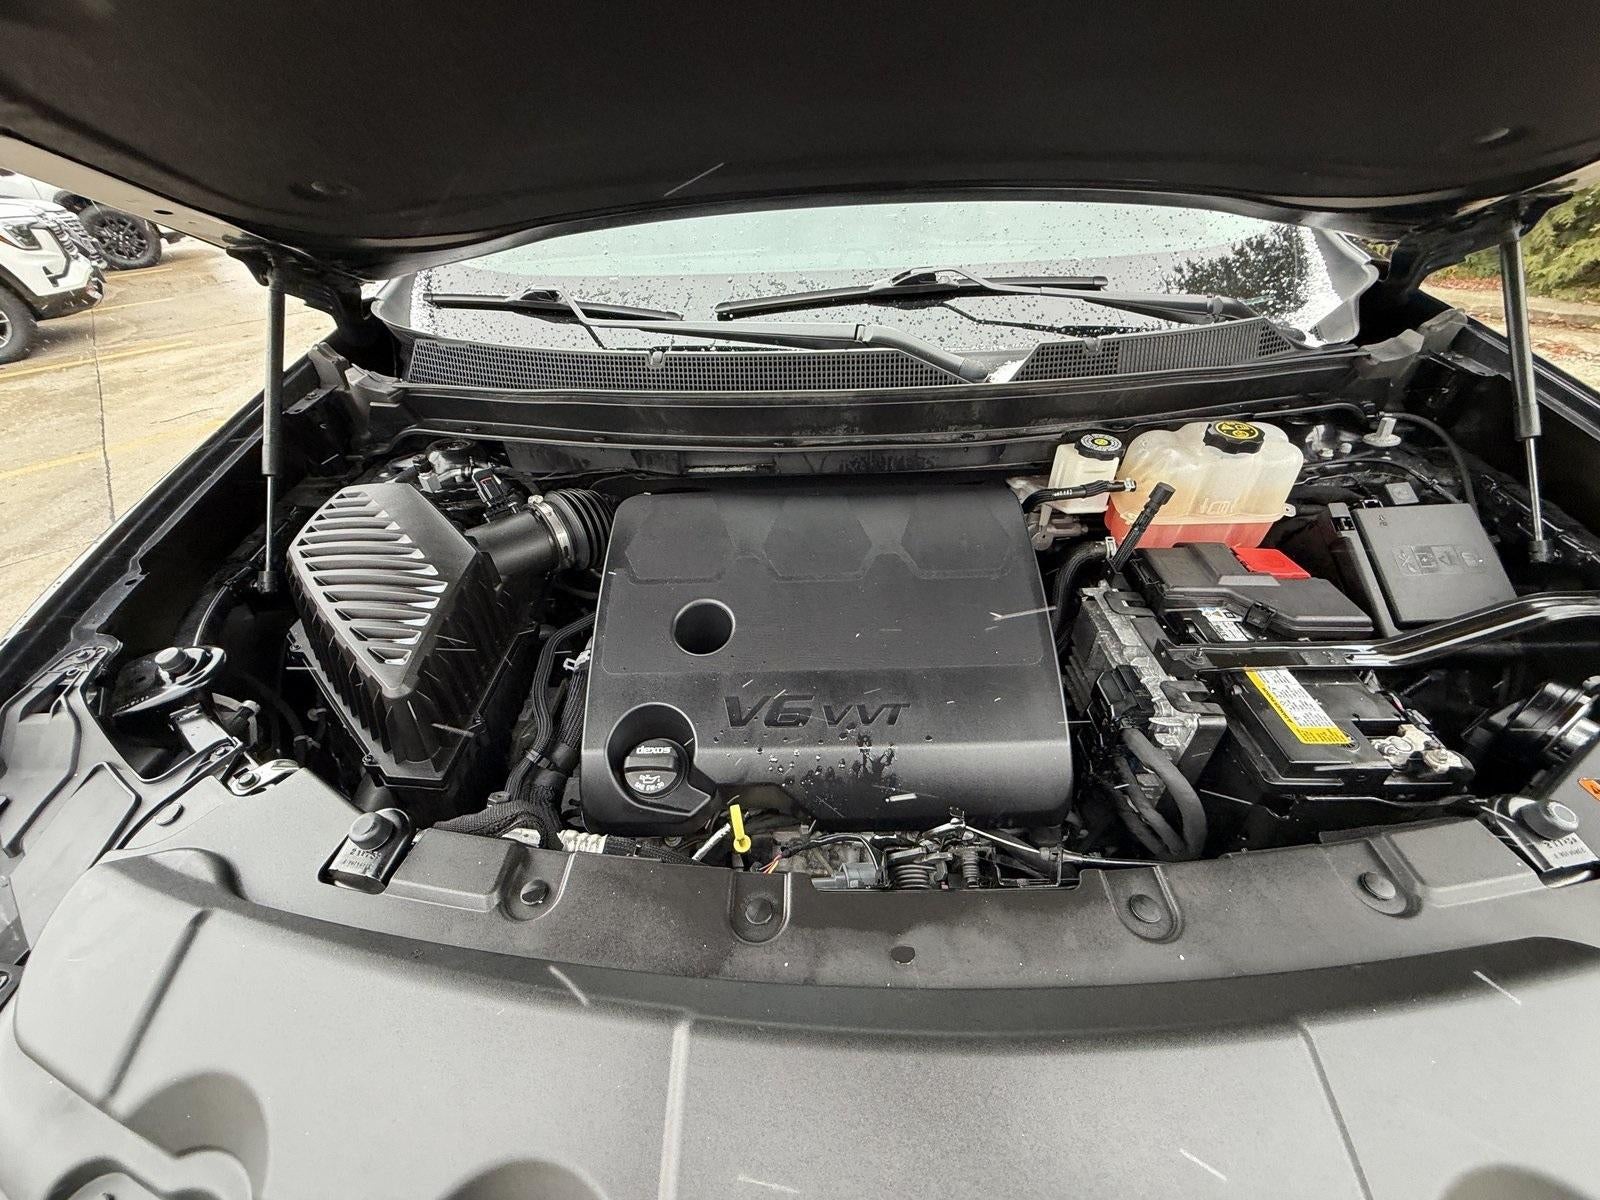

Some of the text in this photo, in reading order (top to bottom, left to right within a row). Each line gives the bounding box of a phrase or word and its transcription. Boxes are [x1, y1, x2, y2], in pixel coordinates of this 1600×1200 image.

[724, 695, 911, 729] V6 VVT
[636, 745, 672, 754] dexos
